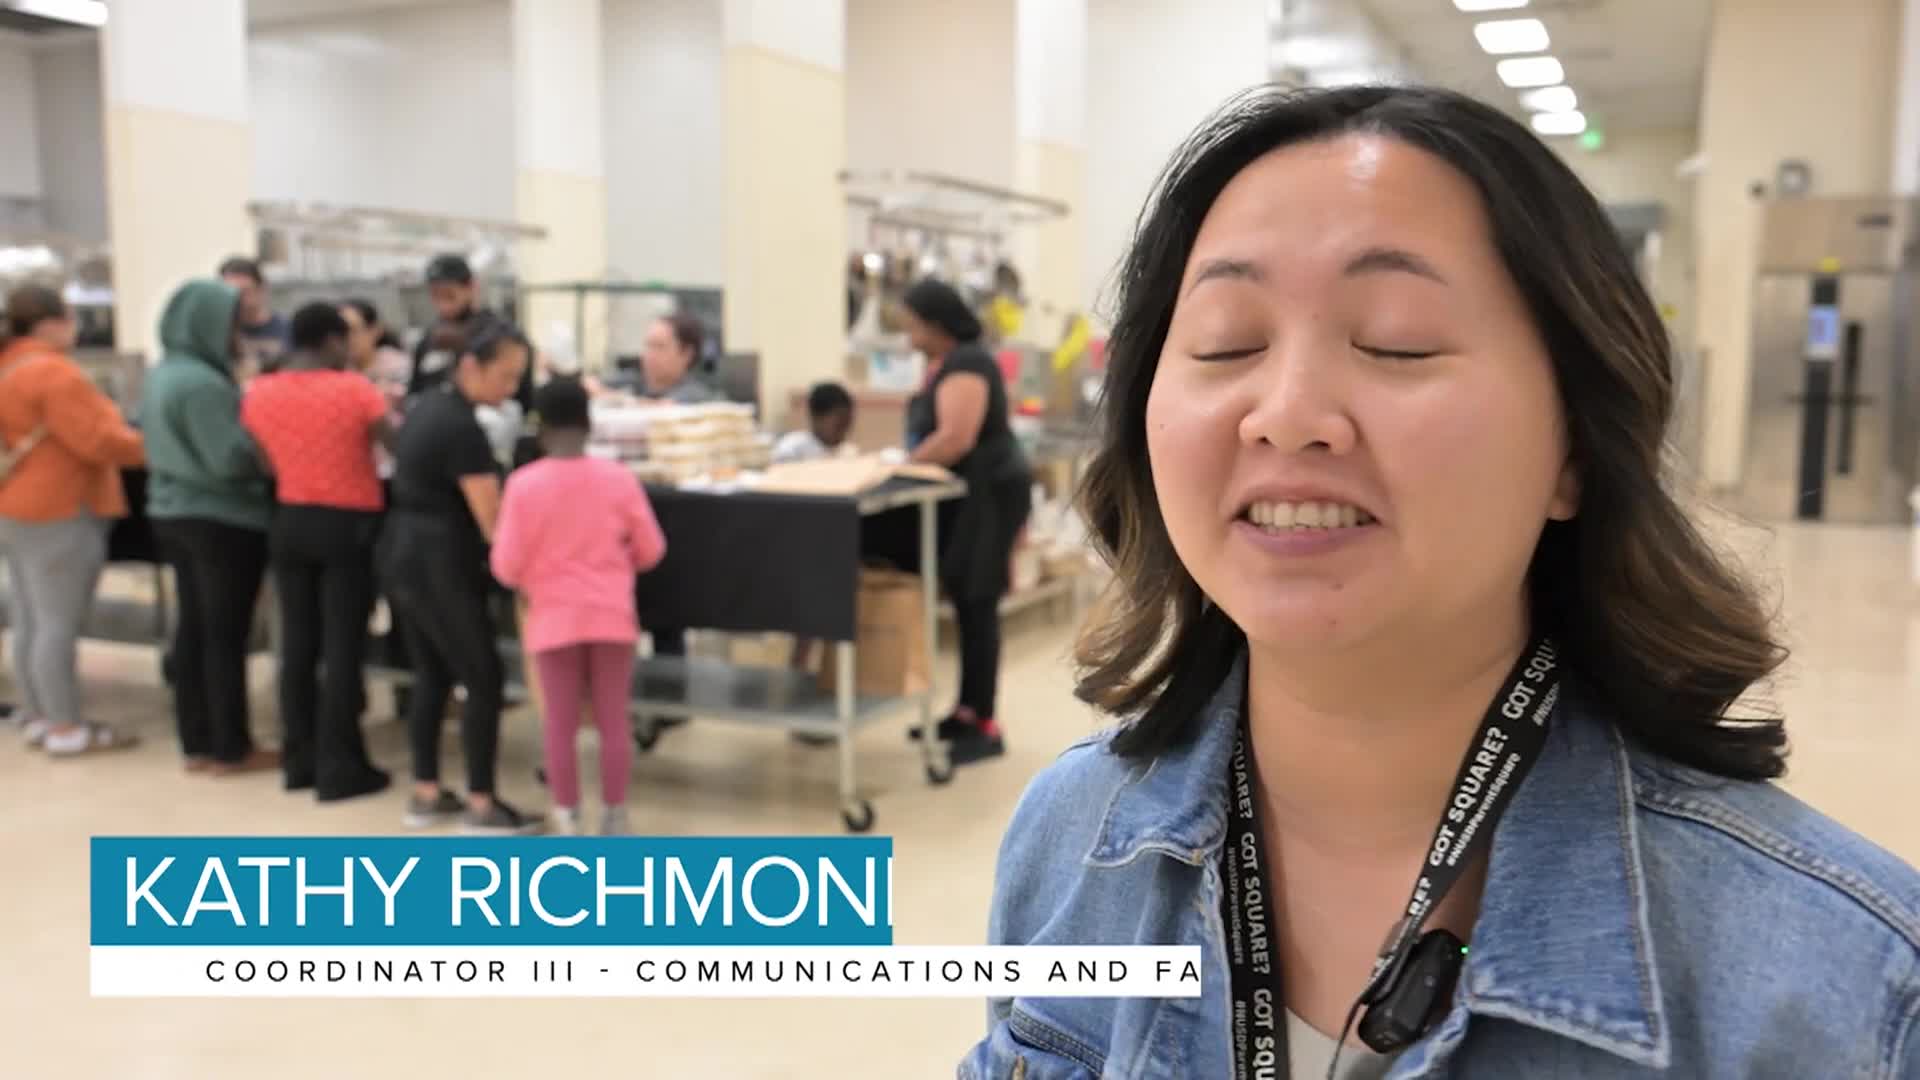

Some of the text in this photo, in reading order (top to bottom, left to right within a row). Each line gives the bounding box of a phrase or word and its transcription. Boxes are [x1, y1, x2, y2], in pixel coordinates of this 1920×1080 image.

[1501, 681, 1536, 720] GOT
[1232, 728, 1254, 819] QUARE?
[1429, 727, 1509, 866] GOT SQUARE?
[1241, 832, 1271, 974] GOT SQUARE?
[1253, 988, 1274, 1030] GOT
